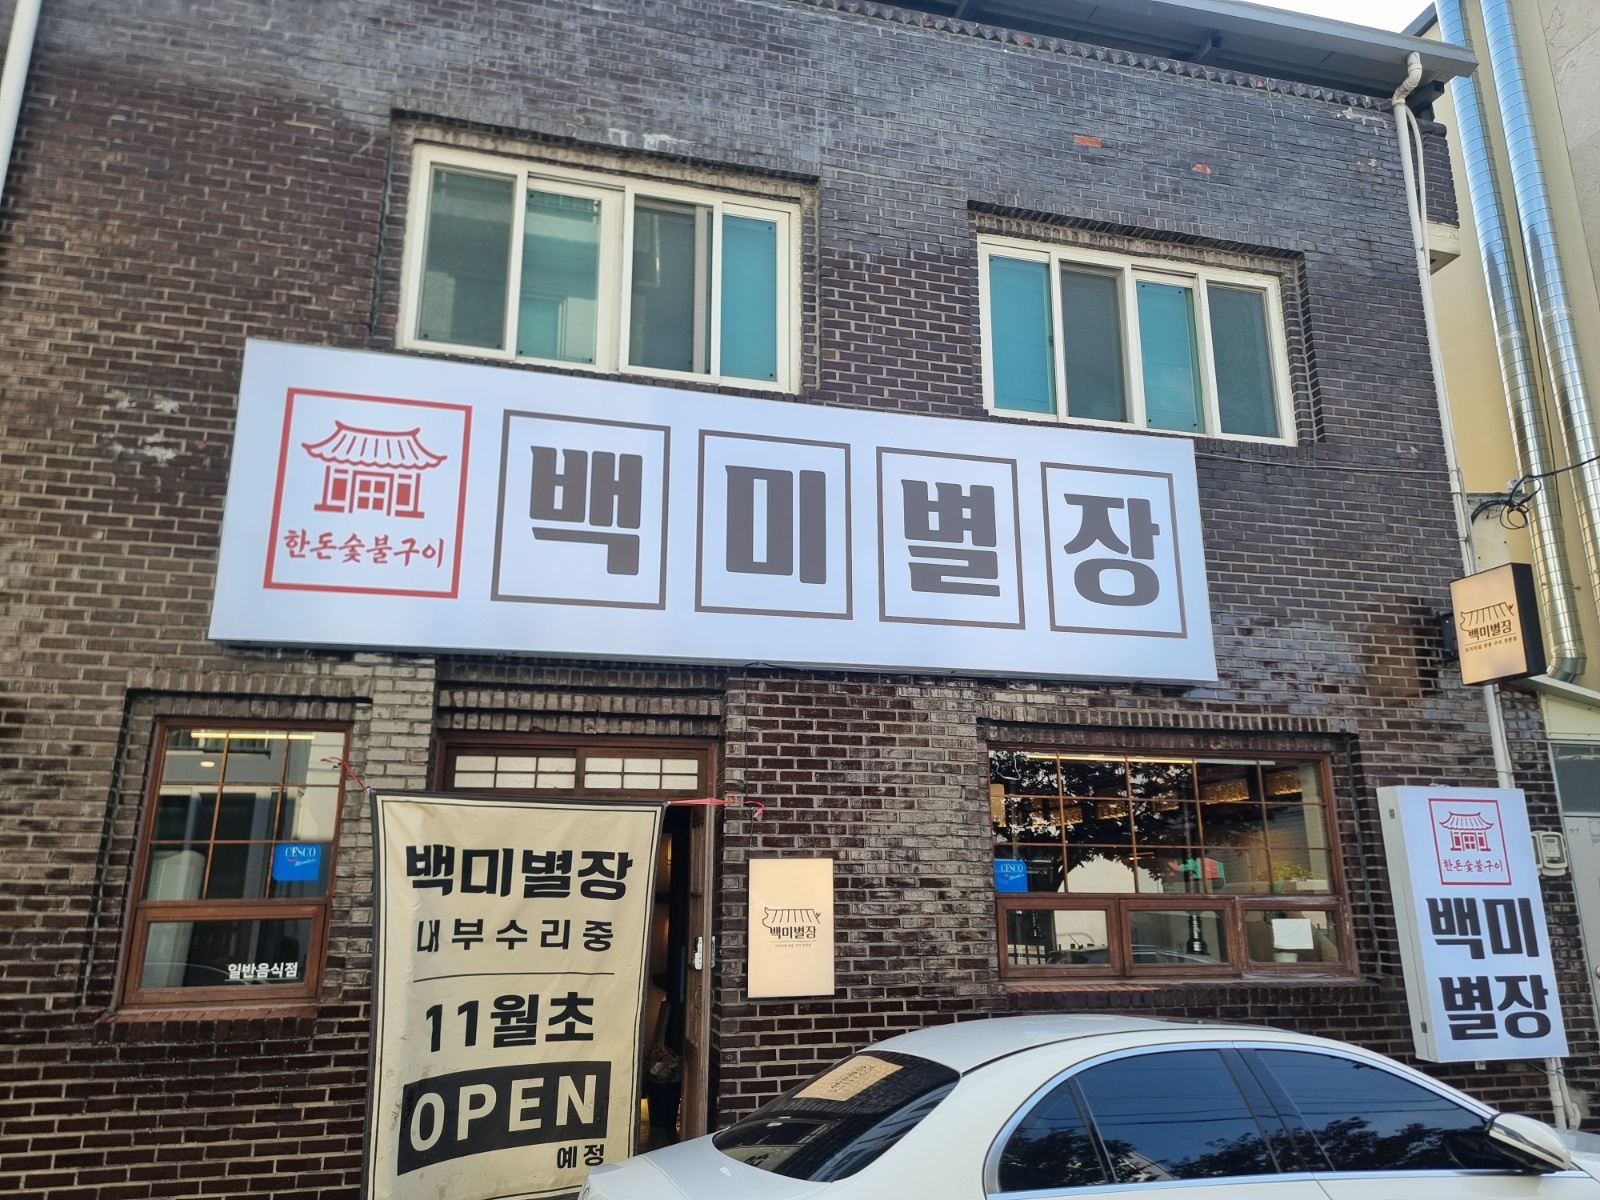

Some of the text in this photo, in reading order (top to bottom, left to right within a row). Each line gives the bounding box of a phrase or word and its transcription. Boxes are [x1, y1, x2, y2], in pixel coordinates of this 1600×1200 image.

[529, 445, 1161, 607] 백미별장
[283, 528, 445, 568] 한돈숯불구이
[1468, 619, 1512, 640] 백미별장
[405, 843, 633, 900] 백미별장
[1442, 858, 1503, 873] 한돈숯불구이
[416, 919, 614, 953] 내부수리중
[769, 925, 817, 940] 백미별장
[1425, 897, 1540, 960] 백미
[227, 961, 299, 980] 일반음식점
[425, 991, 595, 1053] 11월초
[1438, 974, 1552, 1041] 별장
[410, 1074, 597, 1153] OPEN
[556, 1143, 605, 1170] 예정
